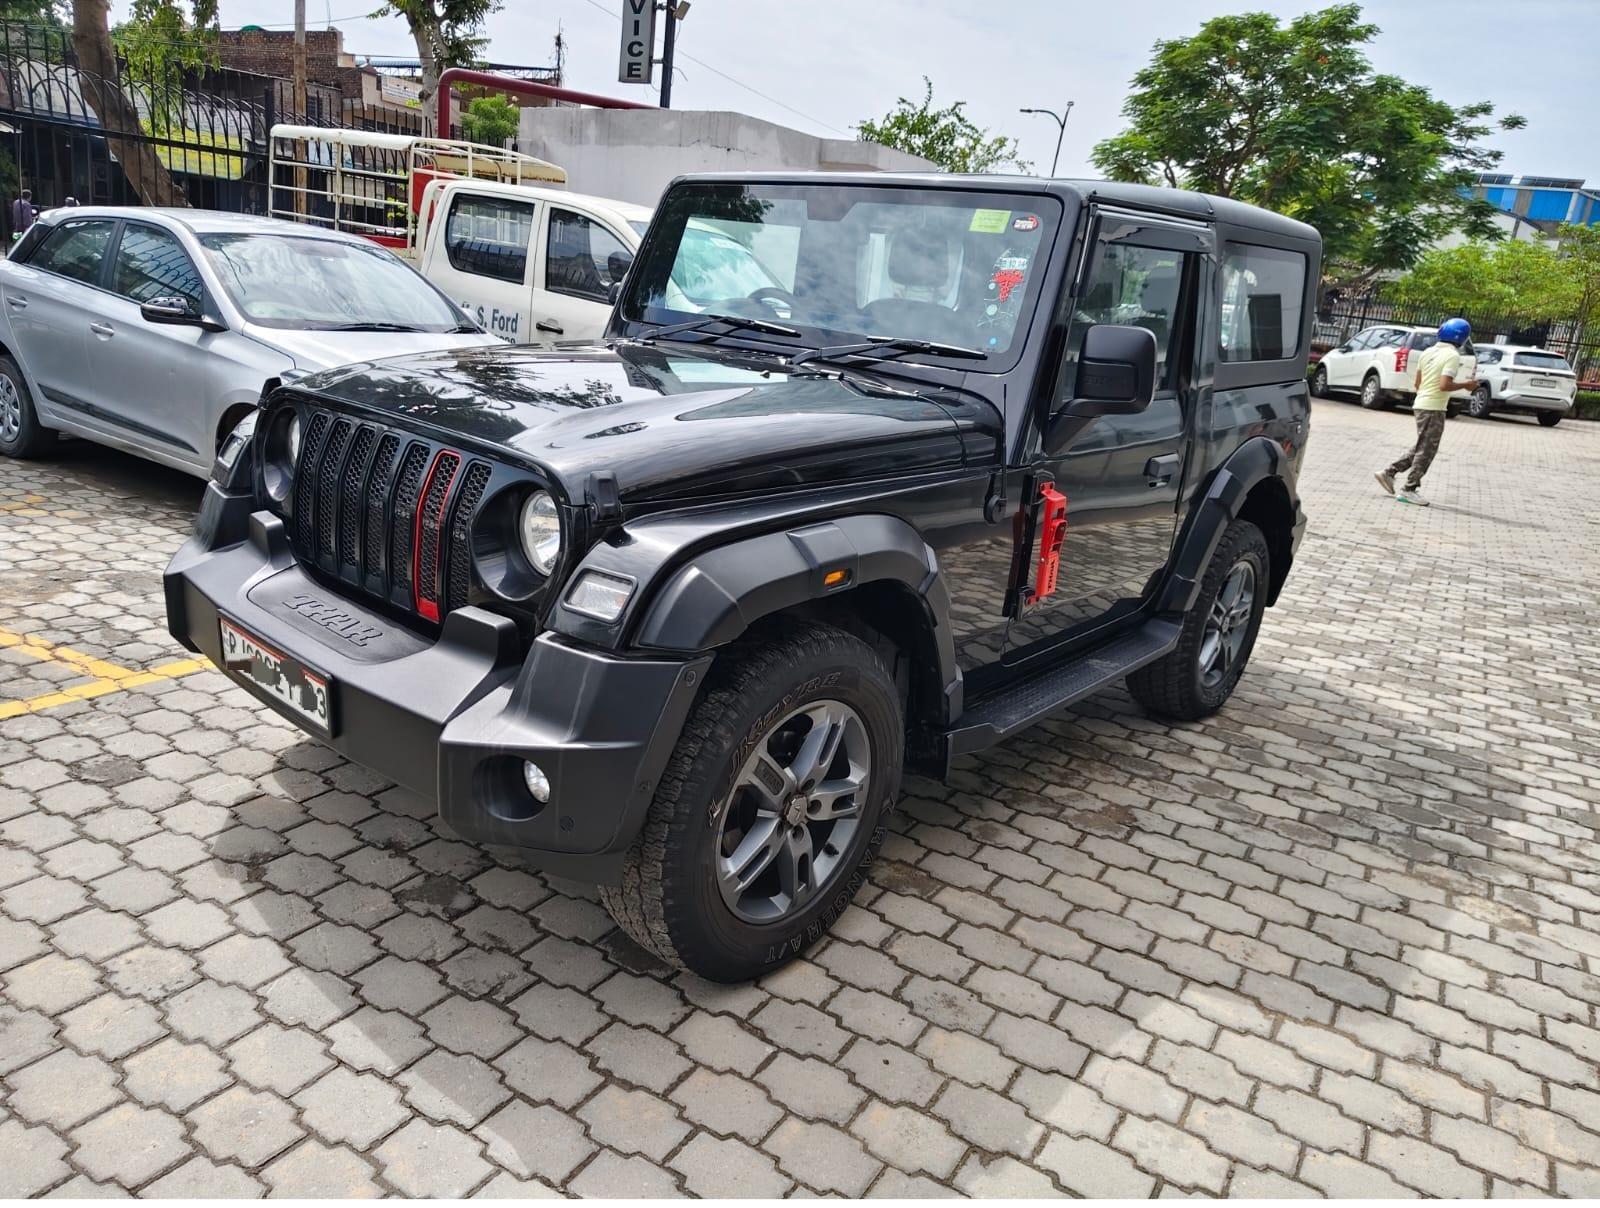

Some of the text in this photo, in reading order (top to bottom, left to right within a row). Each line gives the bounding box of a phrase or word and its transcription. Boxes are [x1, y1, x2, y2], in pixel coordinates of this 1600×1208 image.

[491, 308, 519, 333] Ford
[282, 594, 383, 647] THAR
[765, 826, 888, 964] RANGER A/T
